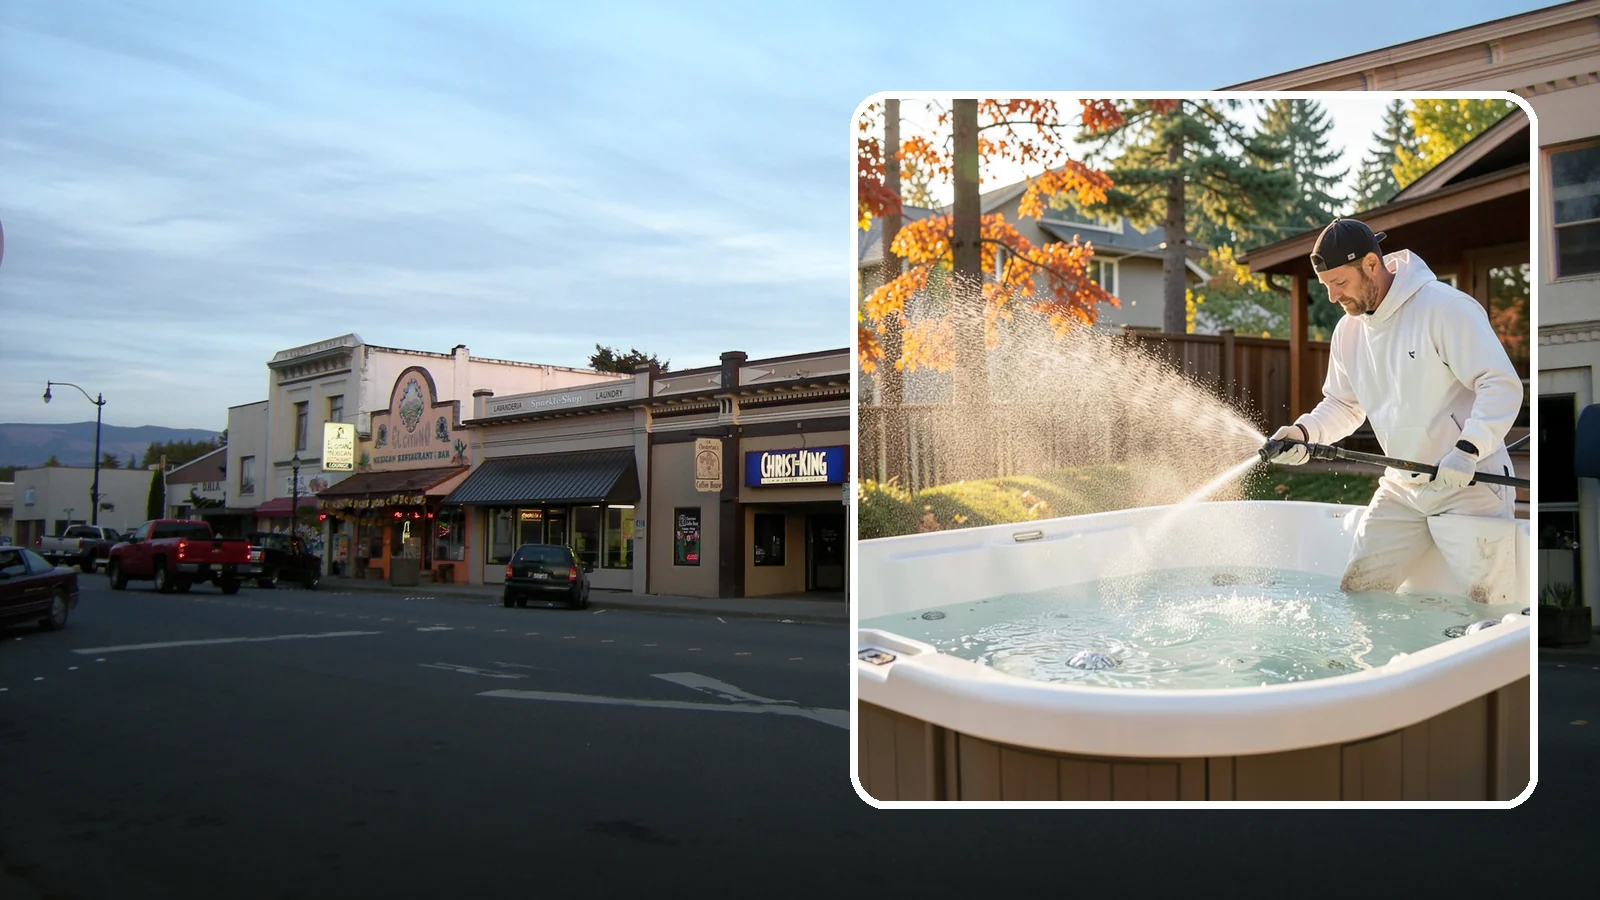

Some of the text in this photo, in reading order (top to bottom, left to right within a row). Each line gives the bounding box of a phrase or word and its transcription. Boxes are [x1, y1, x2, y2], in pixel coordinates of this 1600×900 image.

[531, 394, 582, 408] Sparkle Shop
[595, 389, 624, 400] LAUNDRY
[494, 402, 522, 413] LAVANDERIA
[373, 454, 396, 464] MEXICAN
[398, 451, 433, 462] RESTAURANT
[438, 450, 450, 459] BAR
[760, 450, 827, 478] CHRIST KING
